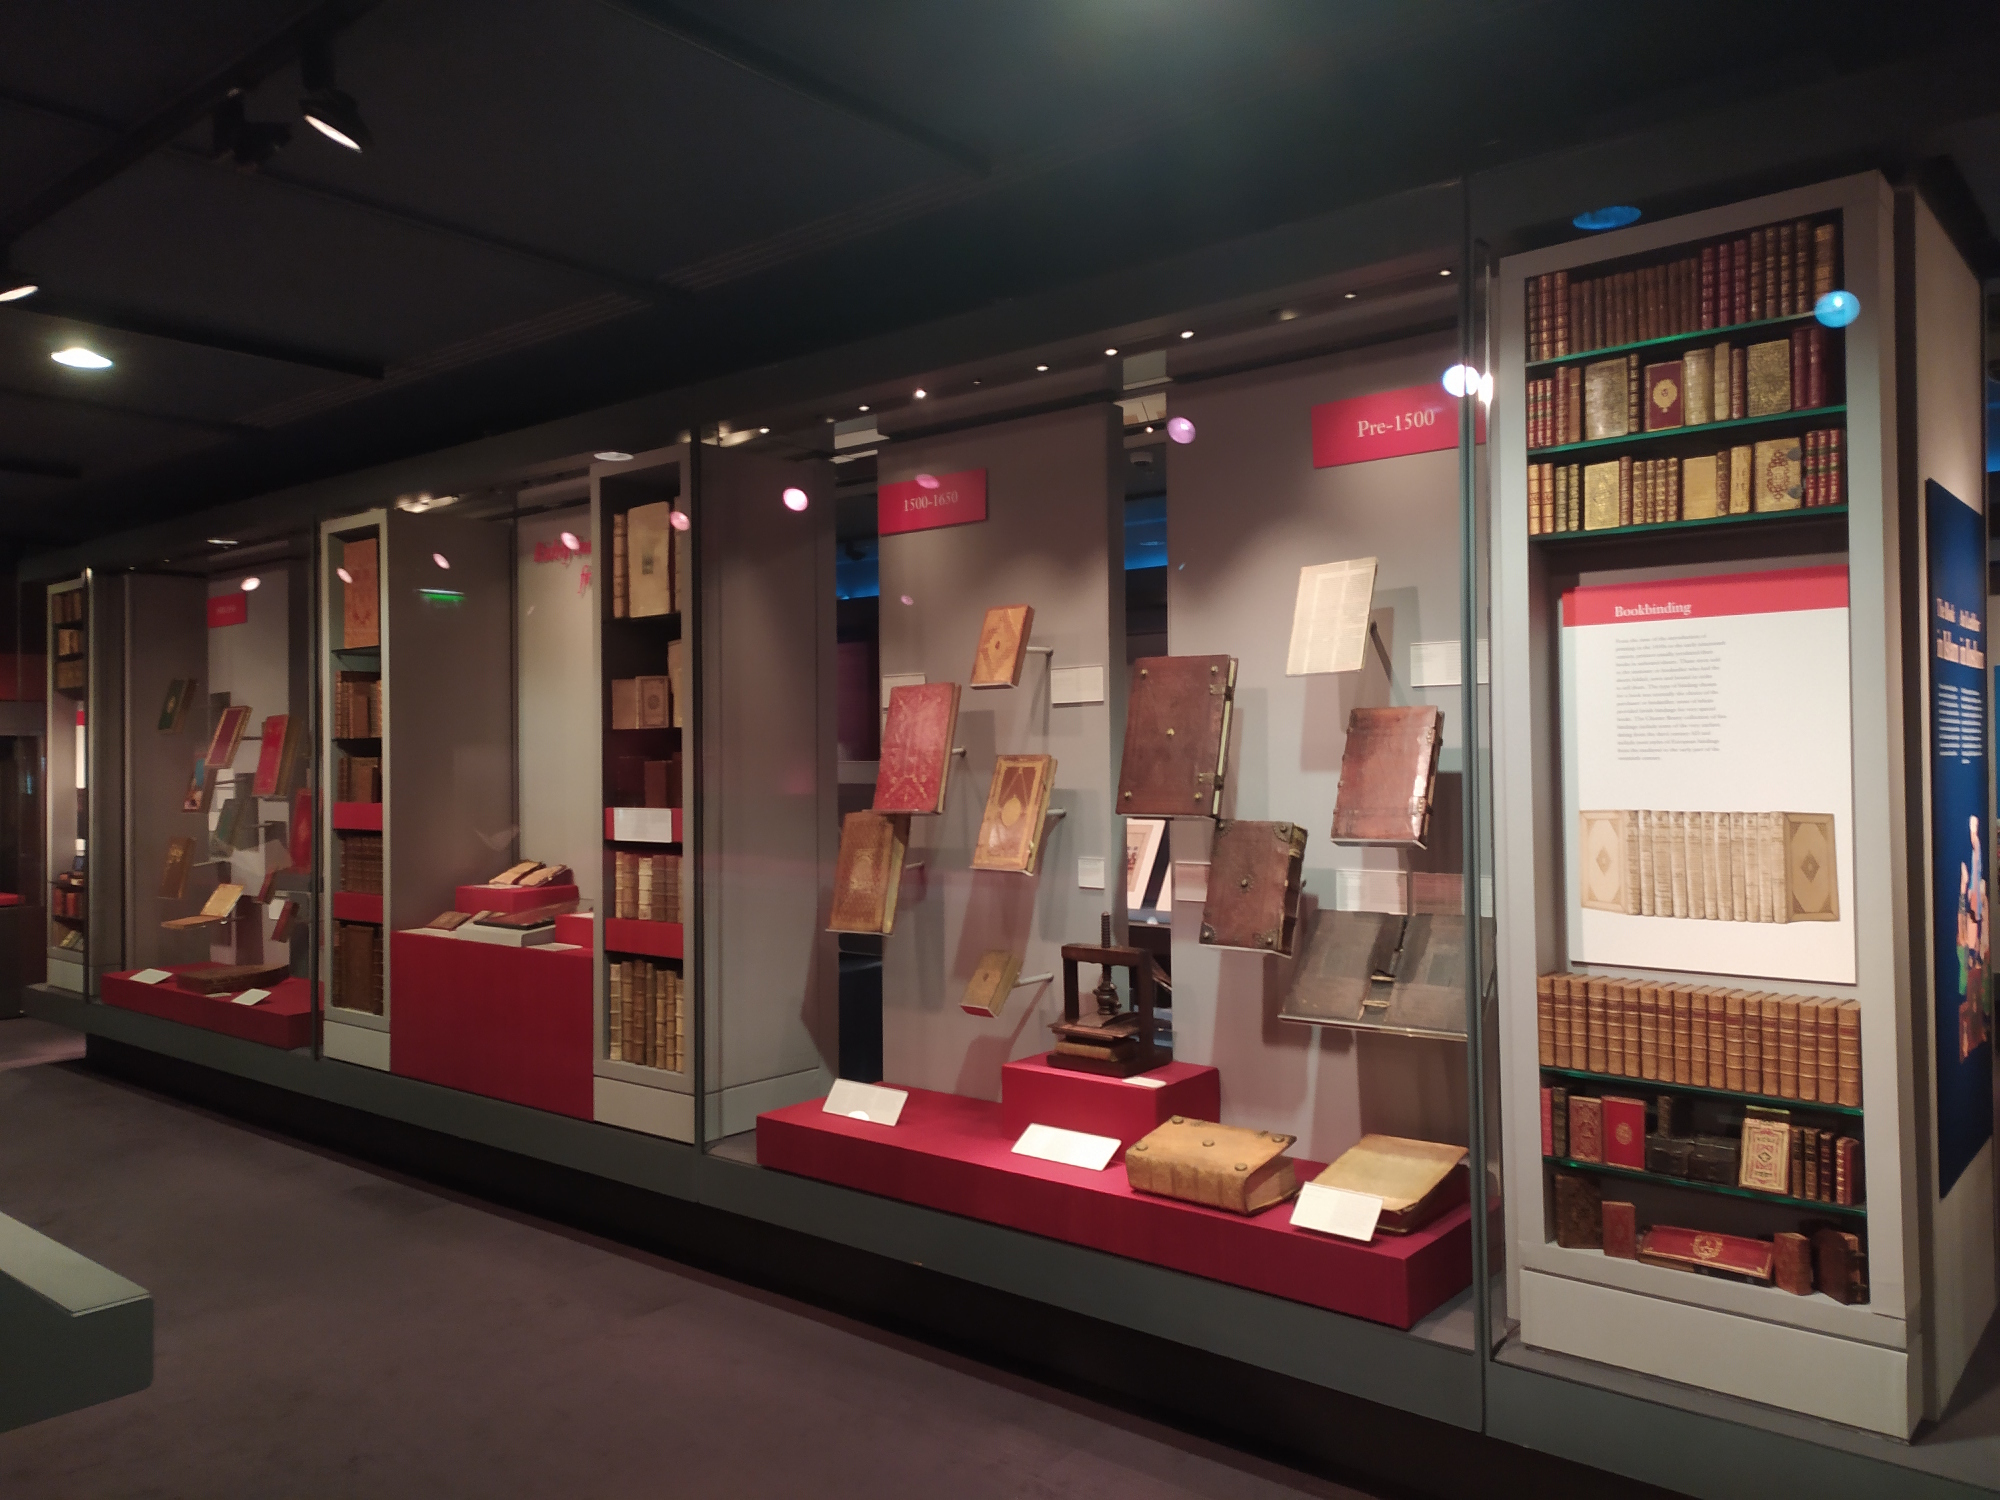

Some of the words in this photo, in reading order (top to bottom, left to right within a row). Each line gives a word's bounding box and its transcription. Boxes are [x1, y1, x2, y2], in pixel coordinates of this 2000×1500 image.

[1358, 409, 1435, 437] Pre-1500
[904, 491, 958, 511] 1500-1650
[1615, 602, 1691, 617] Bookbinding
